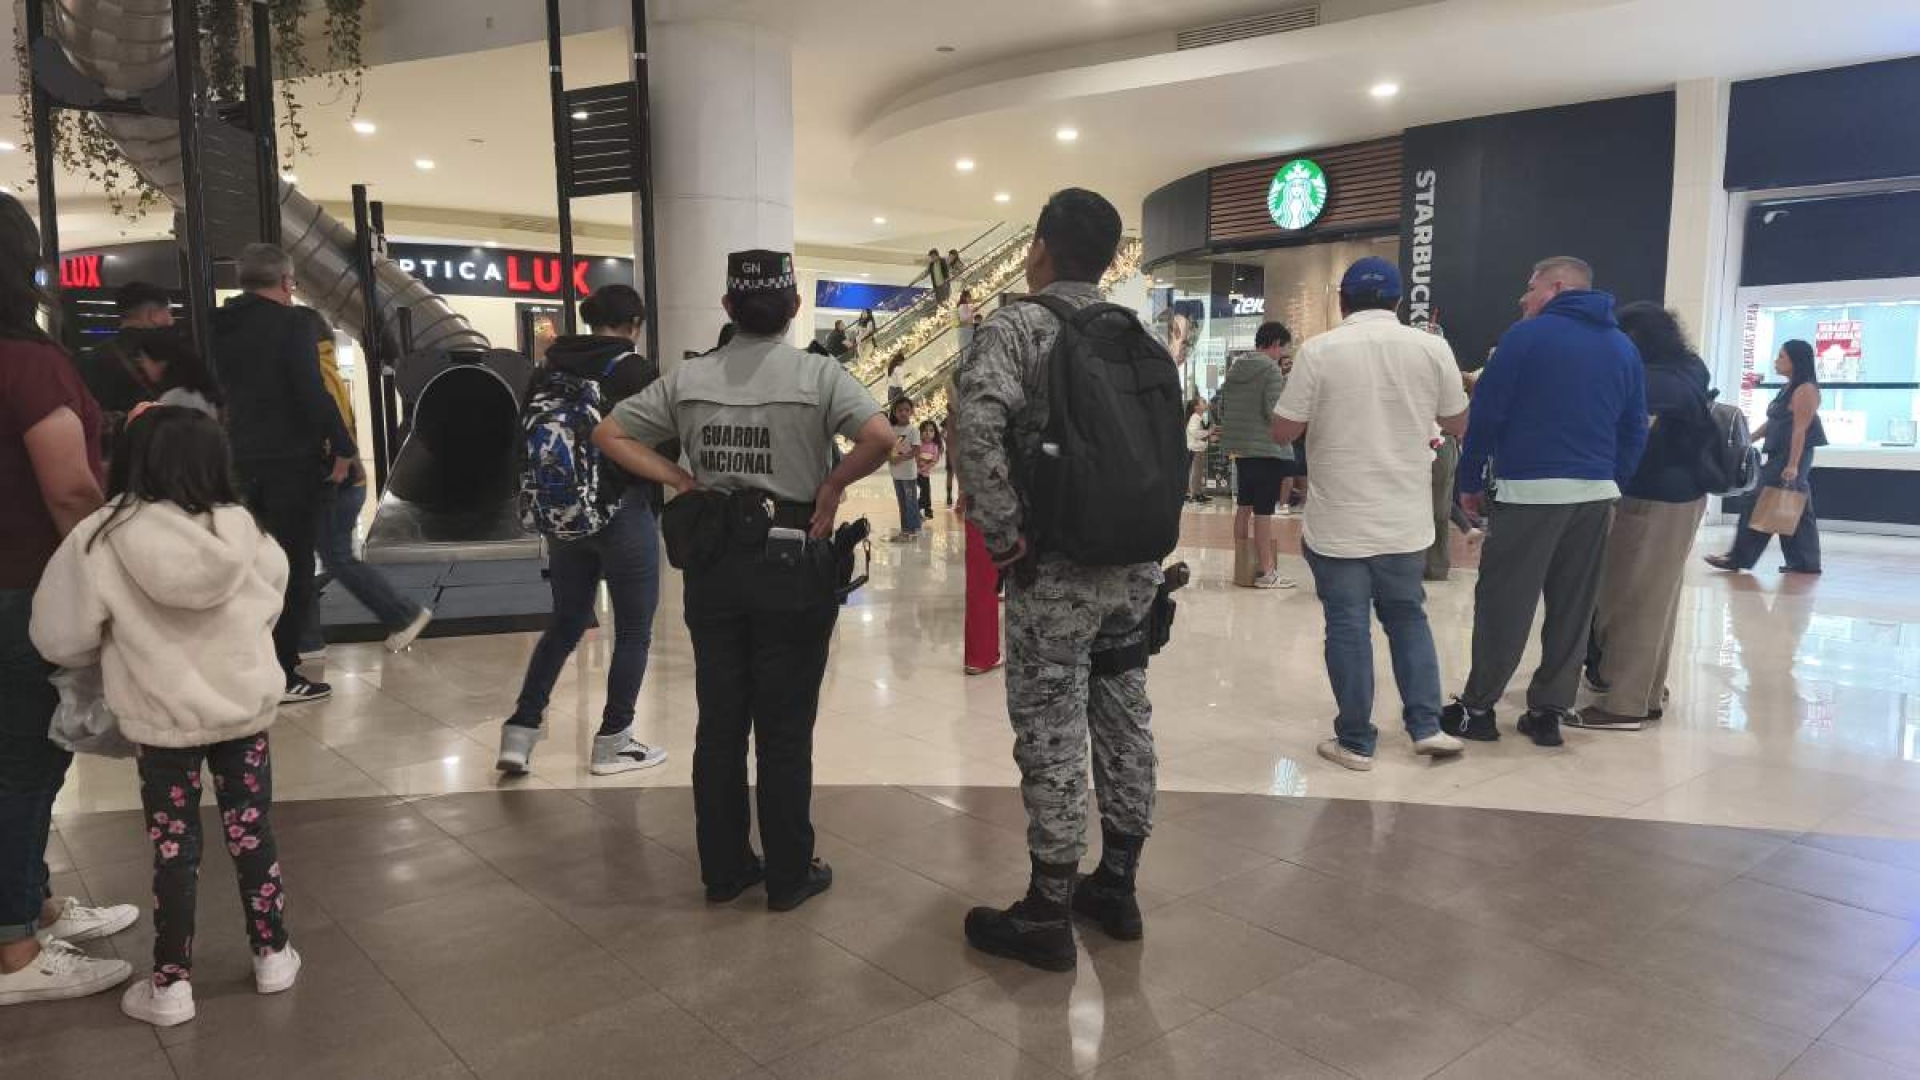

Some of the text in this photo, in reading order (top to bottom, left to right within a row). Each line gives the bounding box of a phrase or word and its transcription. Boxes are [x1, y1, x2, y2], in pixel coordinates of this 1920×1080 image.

[60, 255, 102, 287] LUX
[399, 258, 503, 282] PTICA
[742, 262, 761, 274] GN
[702, 425, 771, 449] GUARDIA
[701, 451, 774, 475] NACIONAL
